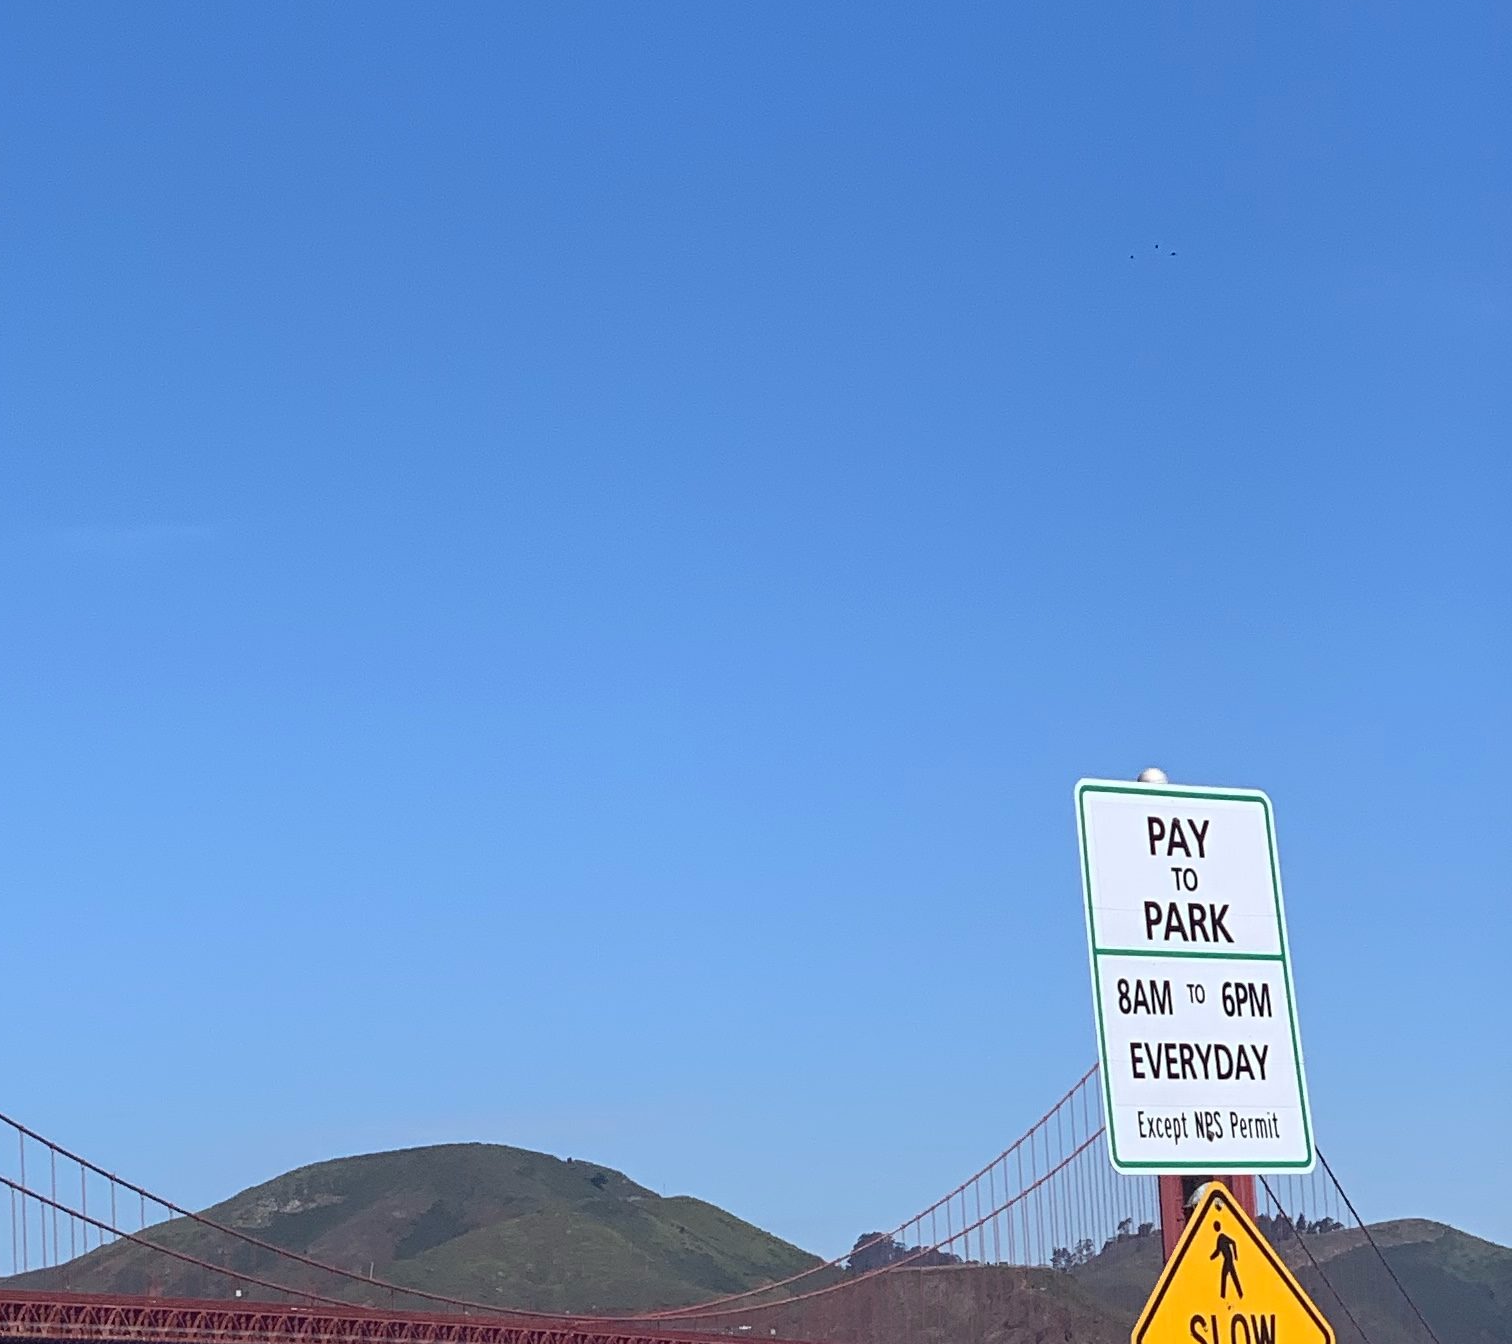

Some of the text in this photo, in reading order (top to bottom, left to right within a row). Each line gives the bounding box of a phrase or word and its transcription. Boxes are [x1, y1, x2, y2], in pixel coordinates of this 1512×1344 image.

[1147, 816, 1209, 858] PAY
[1171, 867, 1198, 892] TO
[1143, 900, 1235, 943] PARK
[1117, 978, 1272, 1018] 8AM TO 6PM
[1129, 1042, 1269, 1081] EVERYDAY
[1137, 1110, 1280, 1146] Except NPS Permit
